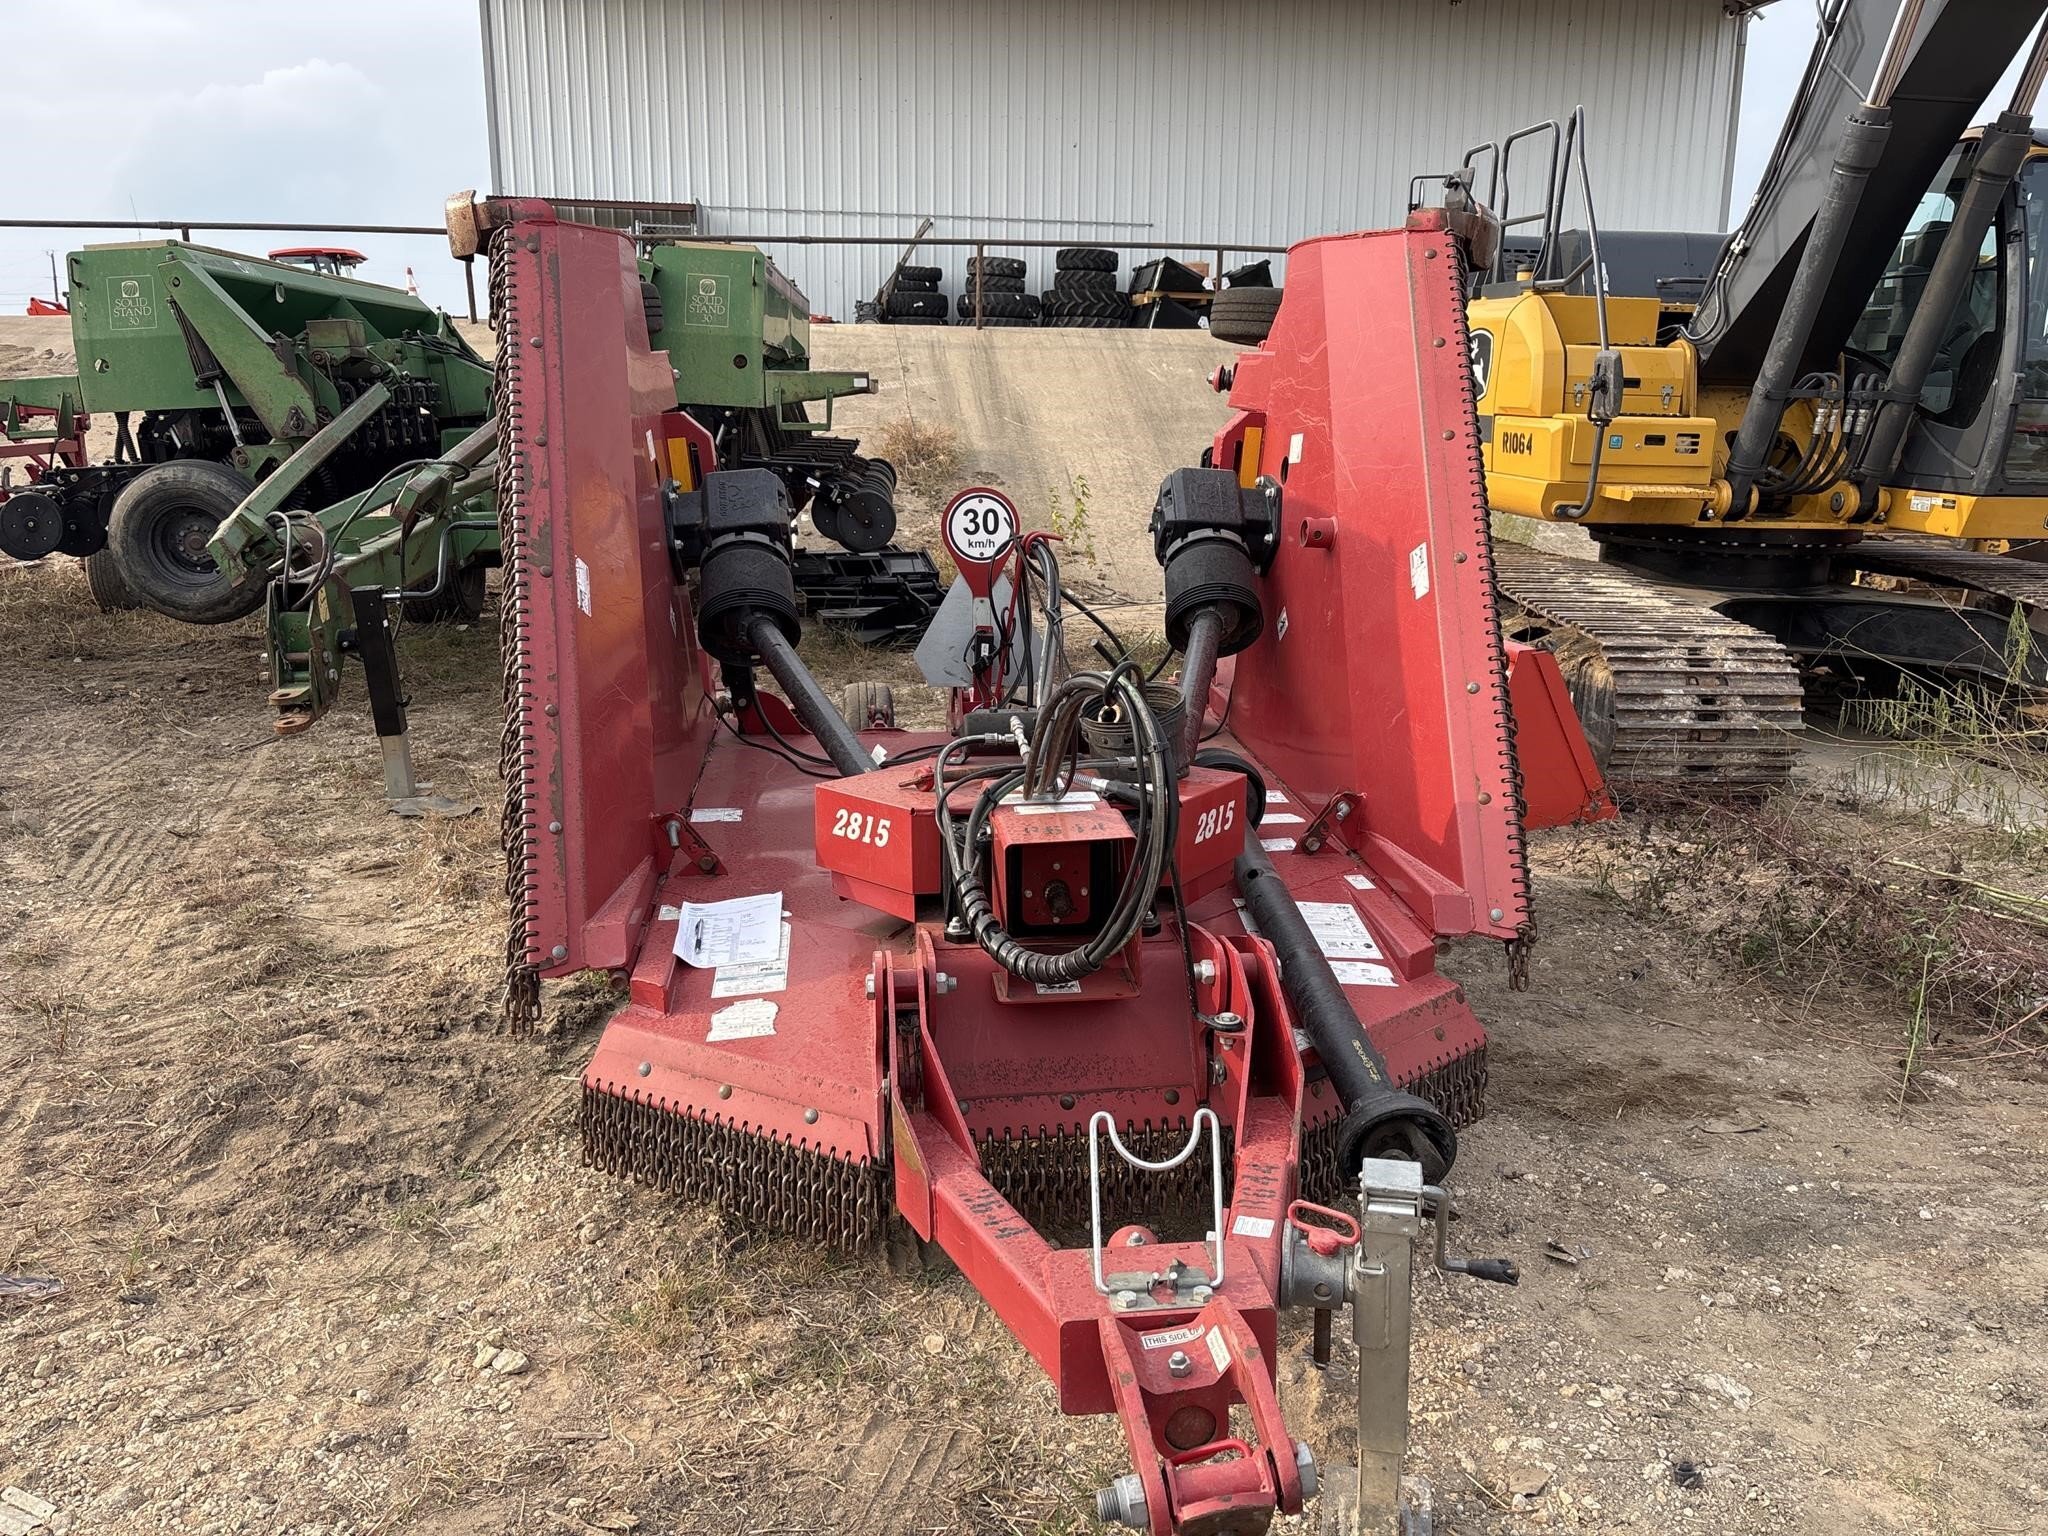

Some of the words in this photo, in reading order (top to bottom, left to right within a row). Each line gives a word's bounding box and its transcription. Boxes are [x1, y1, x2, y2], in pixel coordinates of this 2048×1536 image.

[115, 298, 148, 307] SOLID
[692, 295, 723, 306] SOLID
[113, 306, 152, 317] STAND
[689, 304, 726, 315] STAND
[963, 508, 999, 535] 30
[968, 539, 996, 549] km/h
[832, 808, 891, 848] 2815
[1194, 800, 1236, 845] 2815
[1148, 1335, 1168, 1346] THIS
[1168, 1331, 1189, 1343] SIDE
